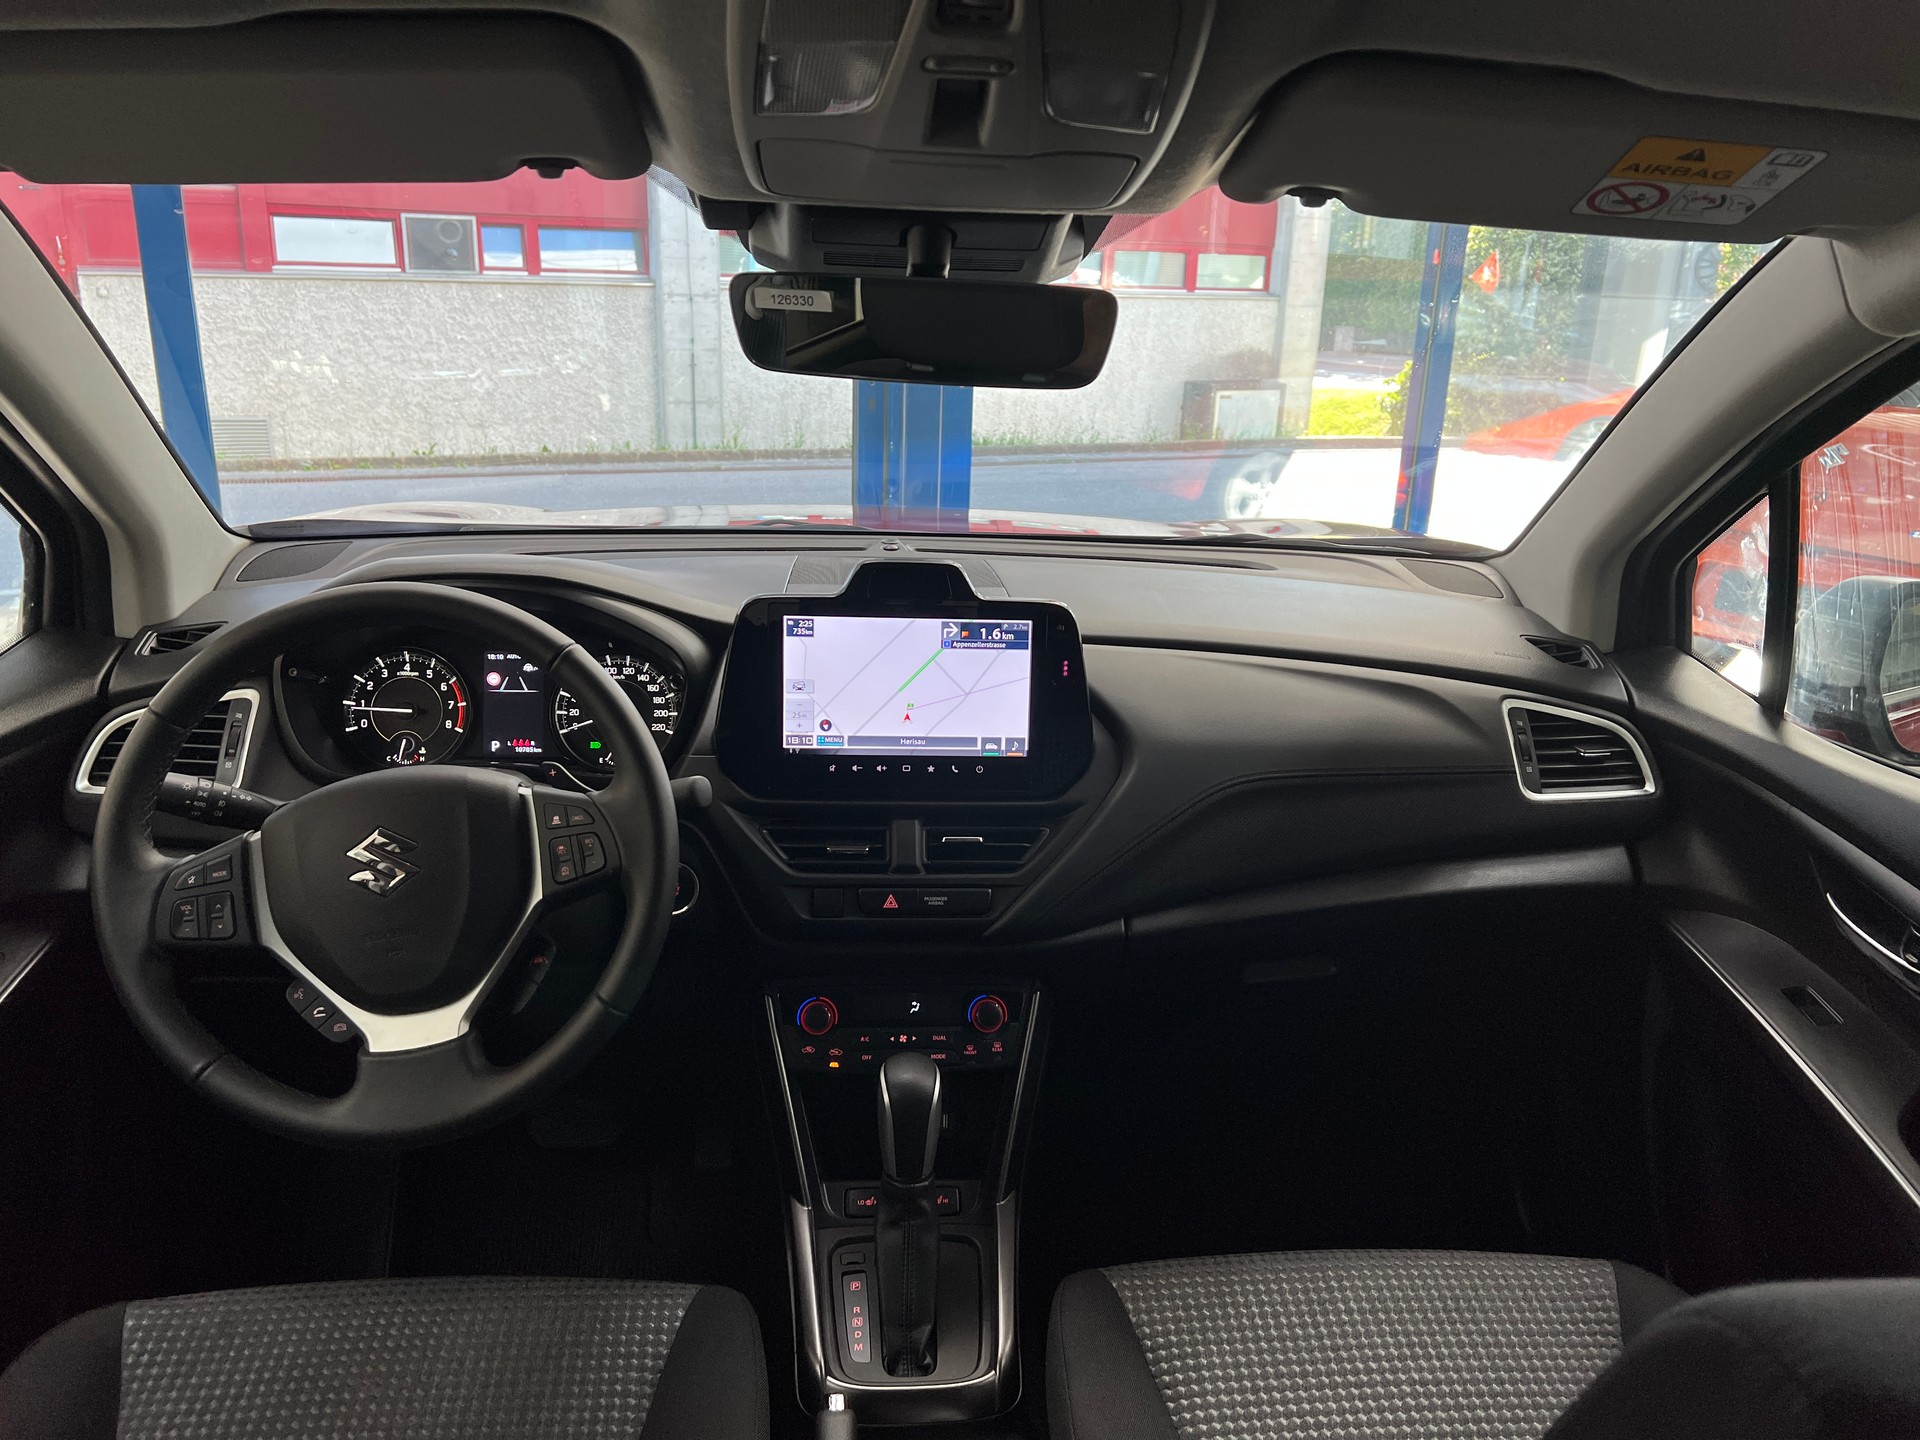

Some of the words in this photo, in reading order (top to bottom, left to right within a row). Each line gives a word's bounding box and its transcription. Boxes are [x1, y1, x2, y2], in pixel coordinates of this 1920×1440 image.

[1622, 163, 1735, 180] AIRBAG
[771, 294, 814, 306] 126330
[980, 627, 1001, 640] 1.6
[952, 641, 1007, 649] Appenzellerstrasse
[403, 663, 411, 672] 4
[622, 667, 635, 675] 120
[381, 669, 388, 678] 3
[426, 669, 434, 678] 5
[637, 674, 650, 682] 140
[366, 681, 374, 690] 2
[440, 682, 448, 691] 6
[647, 684, 660, 692] 160
[653, 696, 665, 704] 180
[447, 700, 455, 710] 7
[569, 708, 580, 716] 20
[653, 709, 669, 717] 200
[360, 719, 368, 728] 0
[445, 720, 453, 729] 8
[651, 723, 666, 731] 220
[787, 736, 814, 744] 18:10
[491, 740, 501, 752] P
[851, 1282, 860, 1291] P
[853, 1318, 862, 1327] N
[854, 1331, 862, 1339] D
[853, 1343, 864, 1351] M
